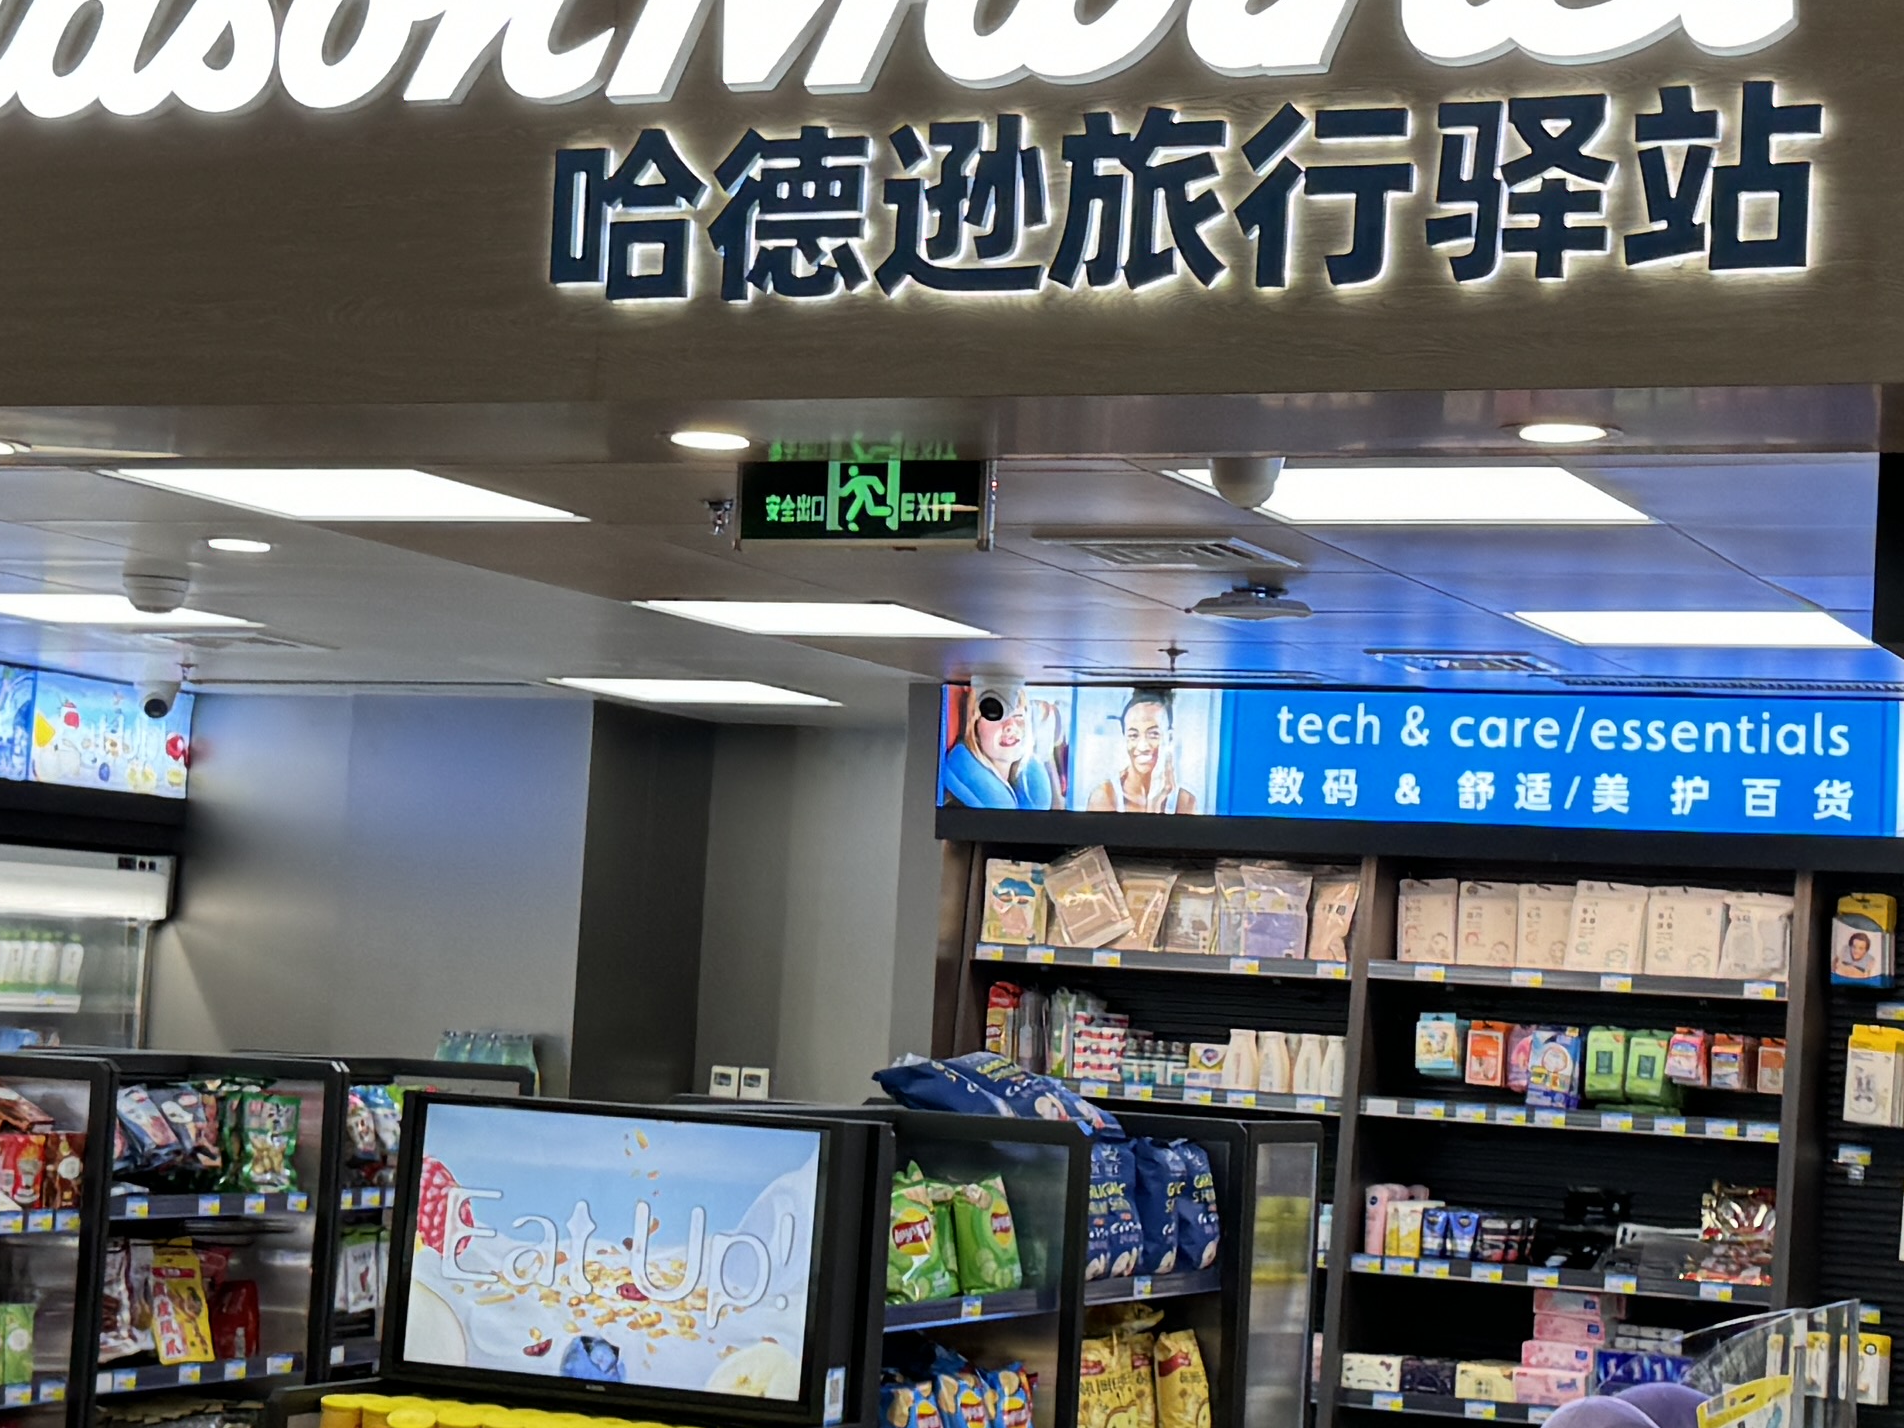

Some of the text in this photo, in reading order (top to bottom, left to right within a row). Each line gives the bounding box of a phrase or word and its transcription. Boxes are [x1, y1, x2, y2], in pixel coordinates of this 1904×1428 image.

[549, 80, 1825, 303] 哈德逊旅行驿站
[765, 492, 956, 523] 安全出口 EXIT
[1277, 703, 1851, 758] tech & care/essentials
[1268, 766, 1358, 807] 数码
[1395, 775, 1421, 806] &
[442, 1186, 795, 1329] Eat Up!
